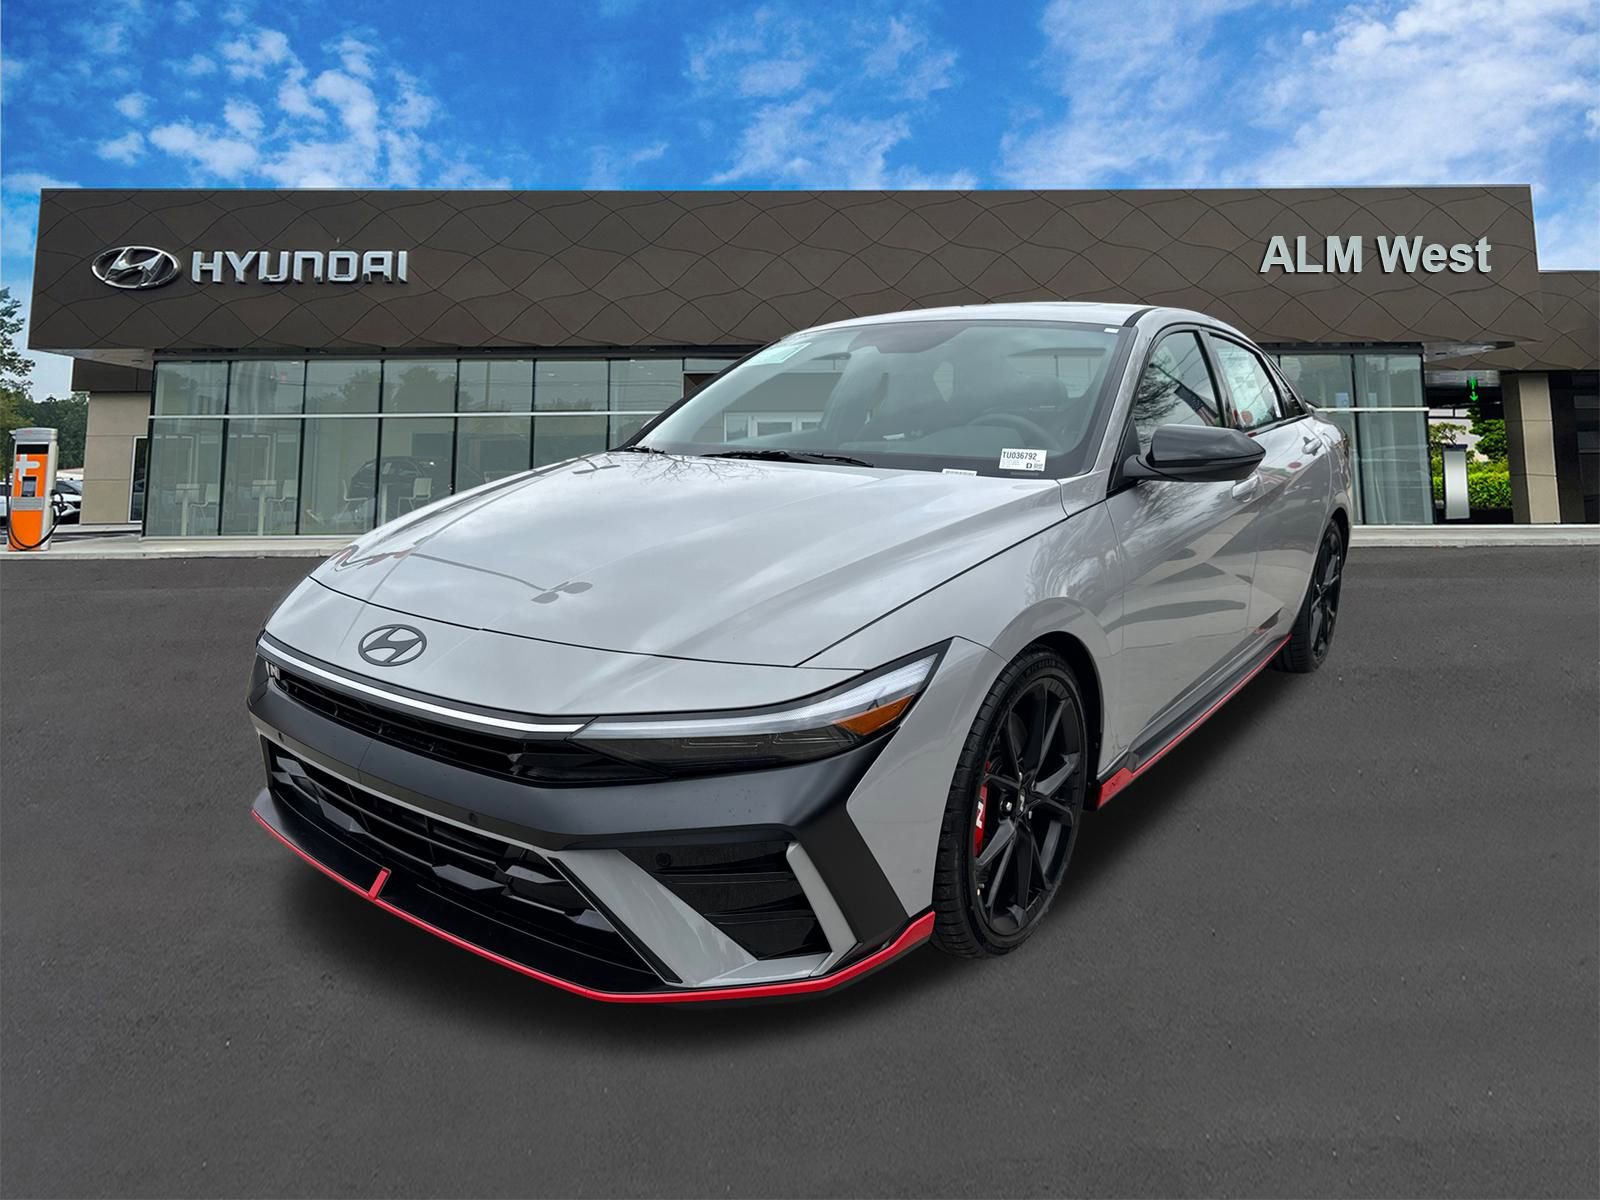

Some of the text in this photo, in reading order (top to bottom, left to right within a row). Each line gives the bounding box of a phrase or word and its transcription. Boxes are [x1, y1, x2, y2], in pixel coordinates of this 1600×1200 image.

[191, 250, 408, 283] HYUNDAI
[1260, 235, 1492, 273] ALM West
[1002, 451, 1038, 461] TU036792
